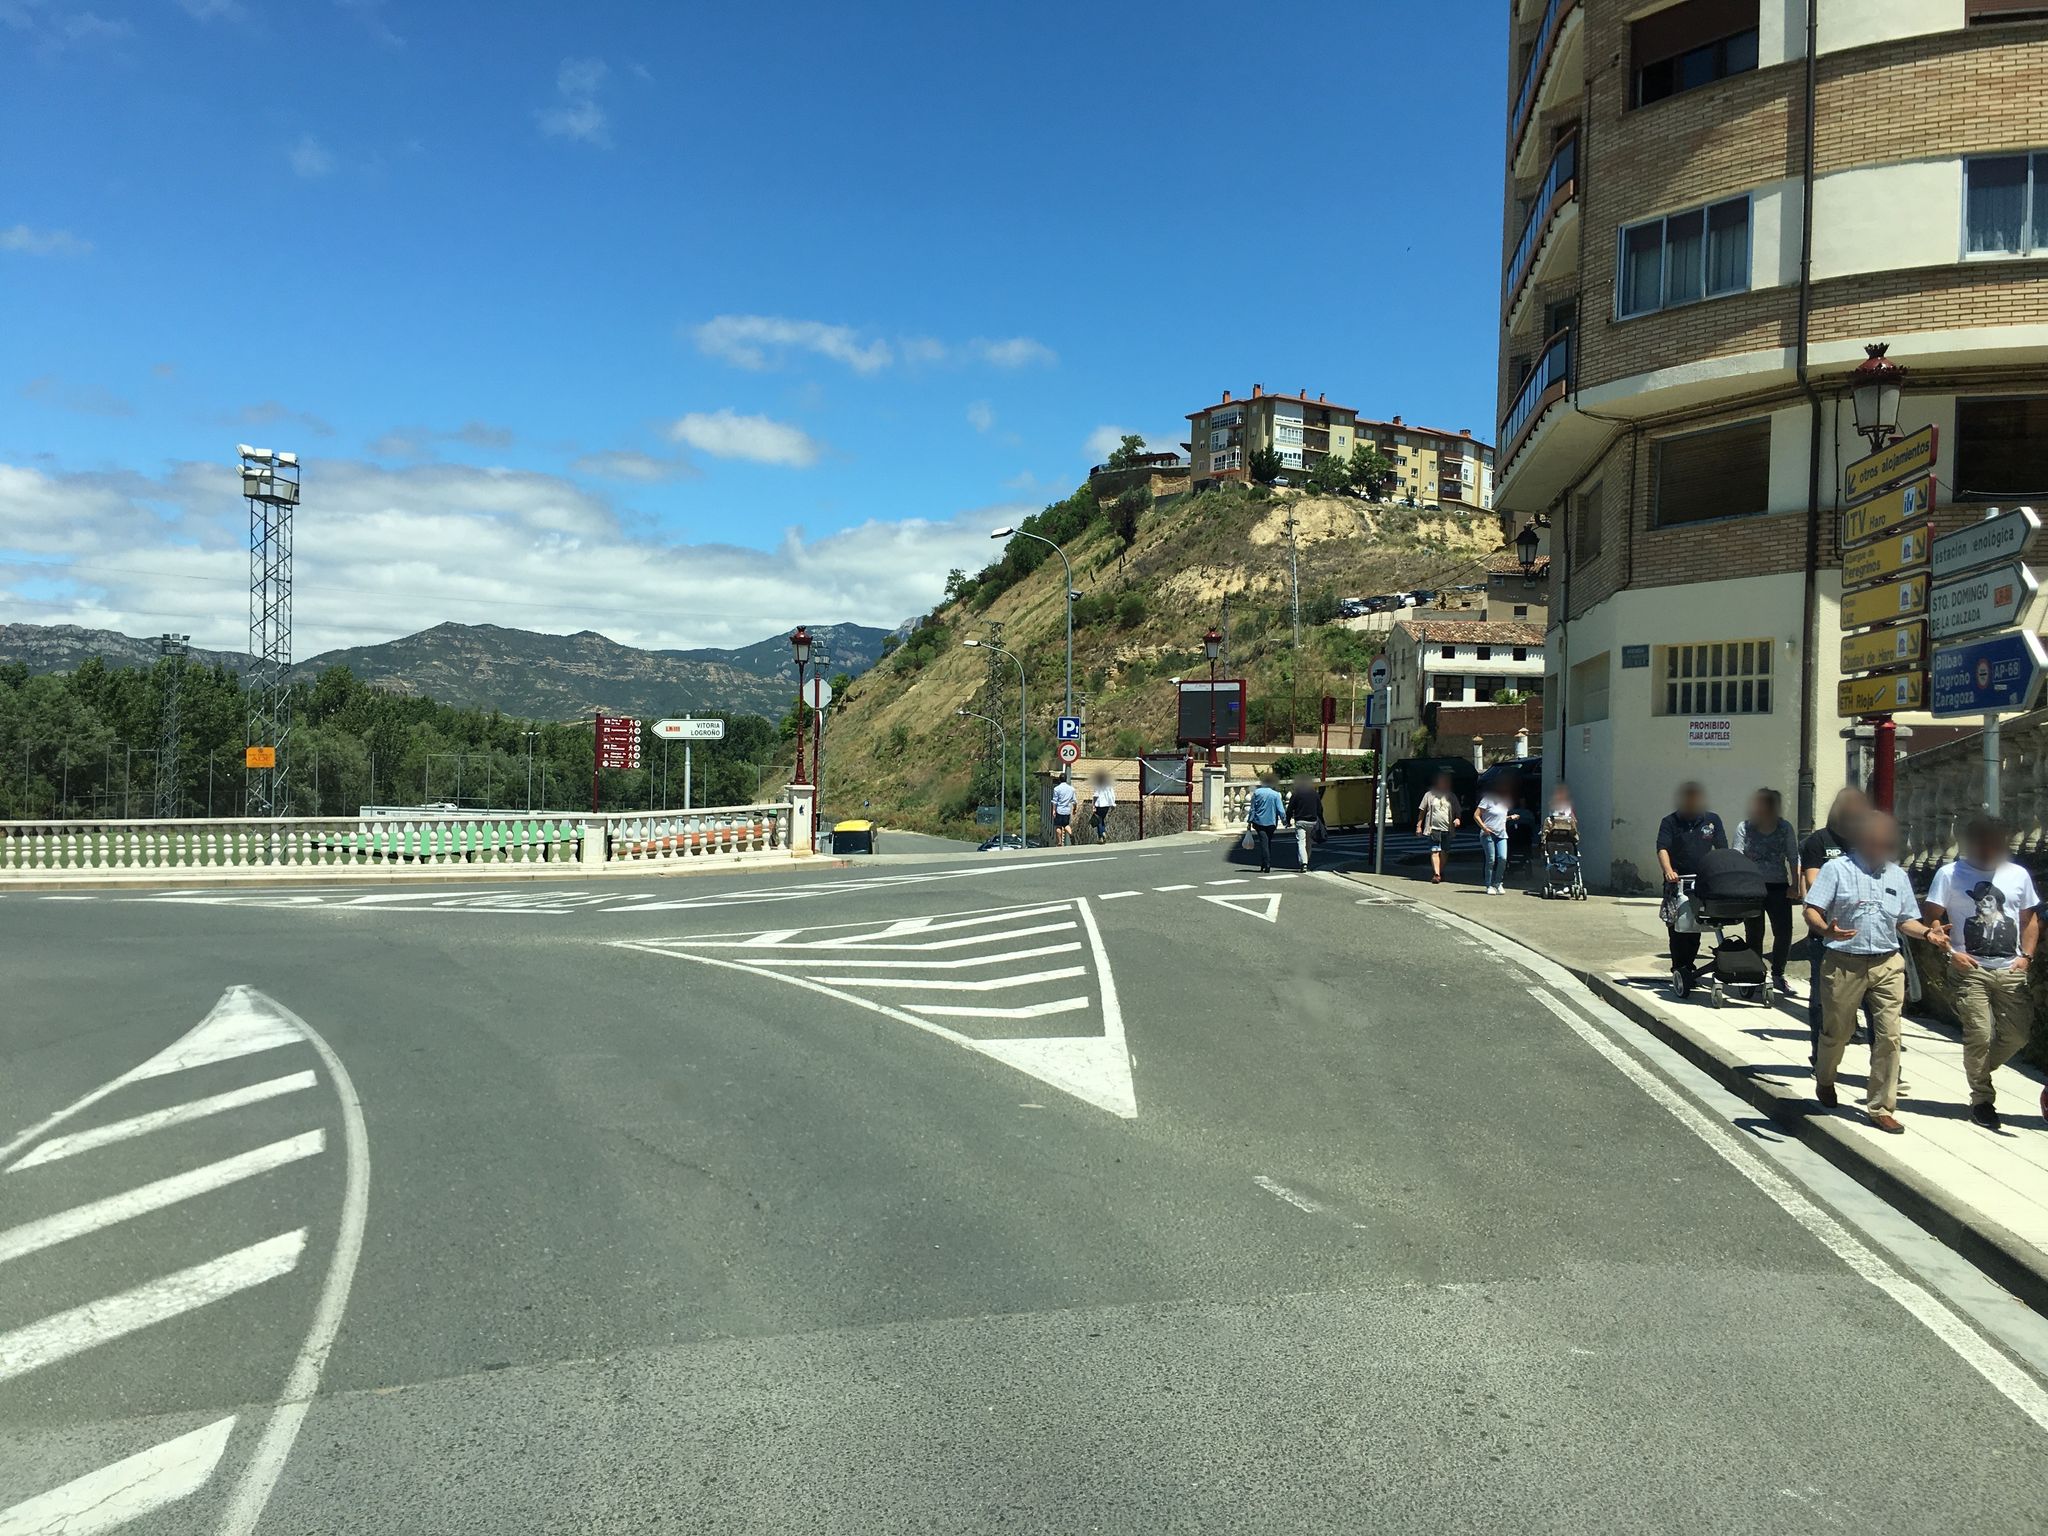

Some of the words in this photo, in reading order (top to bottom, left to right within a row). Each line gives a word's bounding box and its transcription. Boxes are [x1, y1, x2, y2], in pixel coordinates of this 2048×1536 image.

[1860, 466, 1878, 482] otros
[1881, 441, 1930, 472] alojamientos
[1846, 508, 1867, 539] ITV
[1870, 515, 1886, 529] Haro
[1973, 528, 2014, 551] enológica
[1844, 560, 1881, 578] Peregrinos
[1932, 594, 1949, 612] STO.
[1952, 583, 1989, 607] DOMINGO
[1932, 618, 1940, 631] DE
[1941, 615, 1949, 627] LA
[1952, 608, 1980, 626] CALZADA
[1867, 651, 1875, 664] de
[1935, 654, 1963, 670] Bilbao
[1994, 661, 2019, 679] AP-68
[1935, 670, 1970, 690] Logroño
[1856, 694, 1873, 710] Rioja
[1935, 691, 1975, 708] Zaragoza
[1062, 719, 1076, 737] P
[1690, 721, 1730, 730] PROHIBIDO
[1690, 732, 1703, 740] FIJAR
[1704, 731, 1730, 740] CARTELES
[1062, 748, 1075, 757] 20
[1825, 849, 1842, 857] RIP
